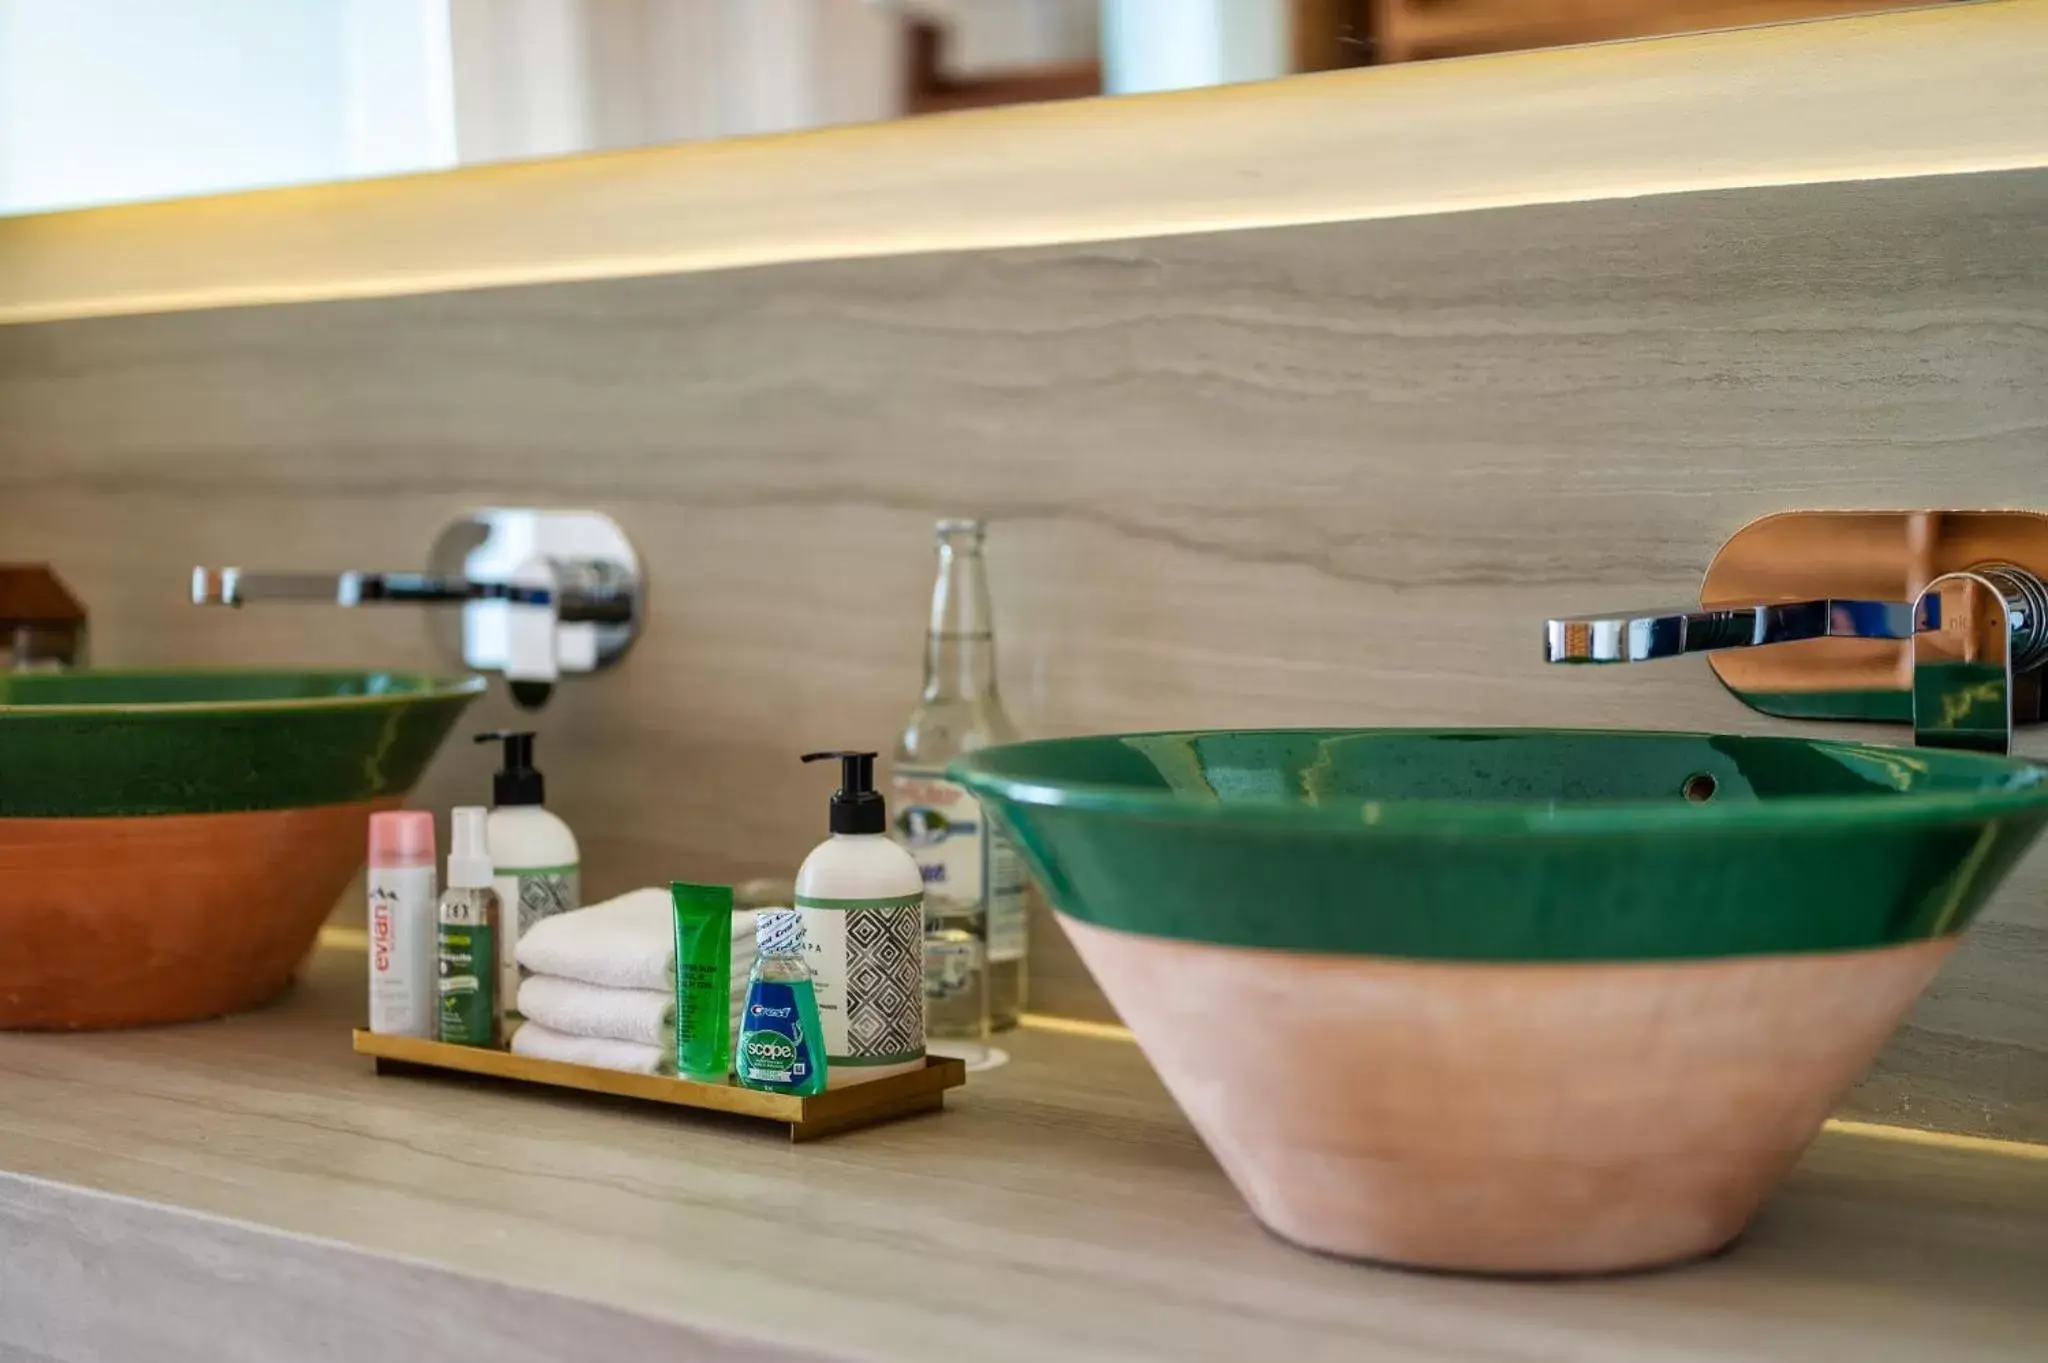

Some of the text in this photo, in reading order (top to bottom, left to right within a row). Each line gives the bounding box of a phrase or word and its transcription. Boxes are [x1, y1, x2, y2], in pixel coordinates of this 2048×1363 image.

[374, 904, 389, 971] evian
[750, 1004, 791, 1018] Crest
[748, 1042, 792, 1060] scope
